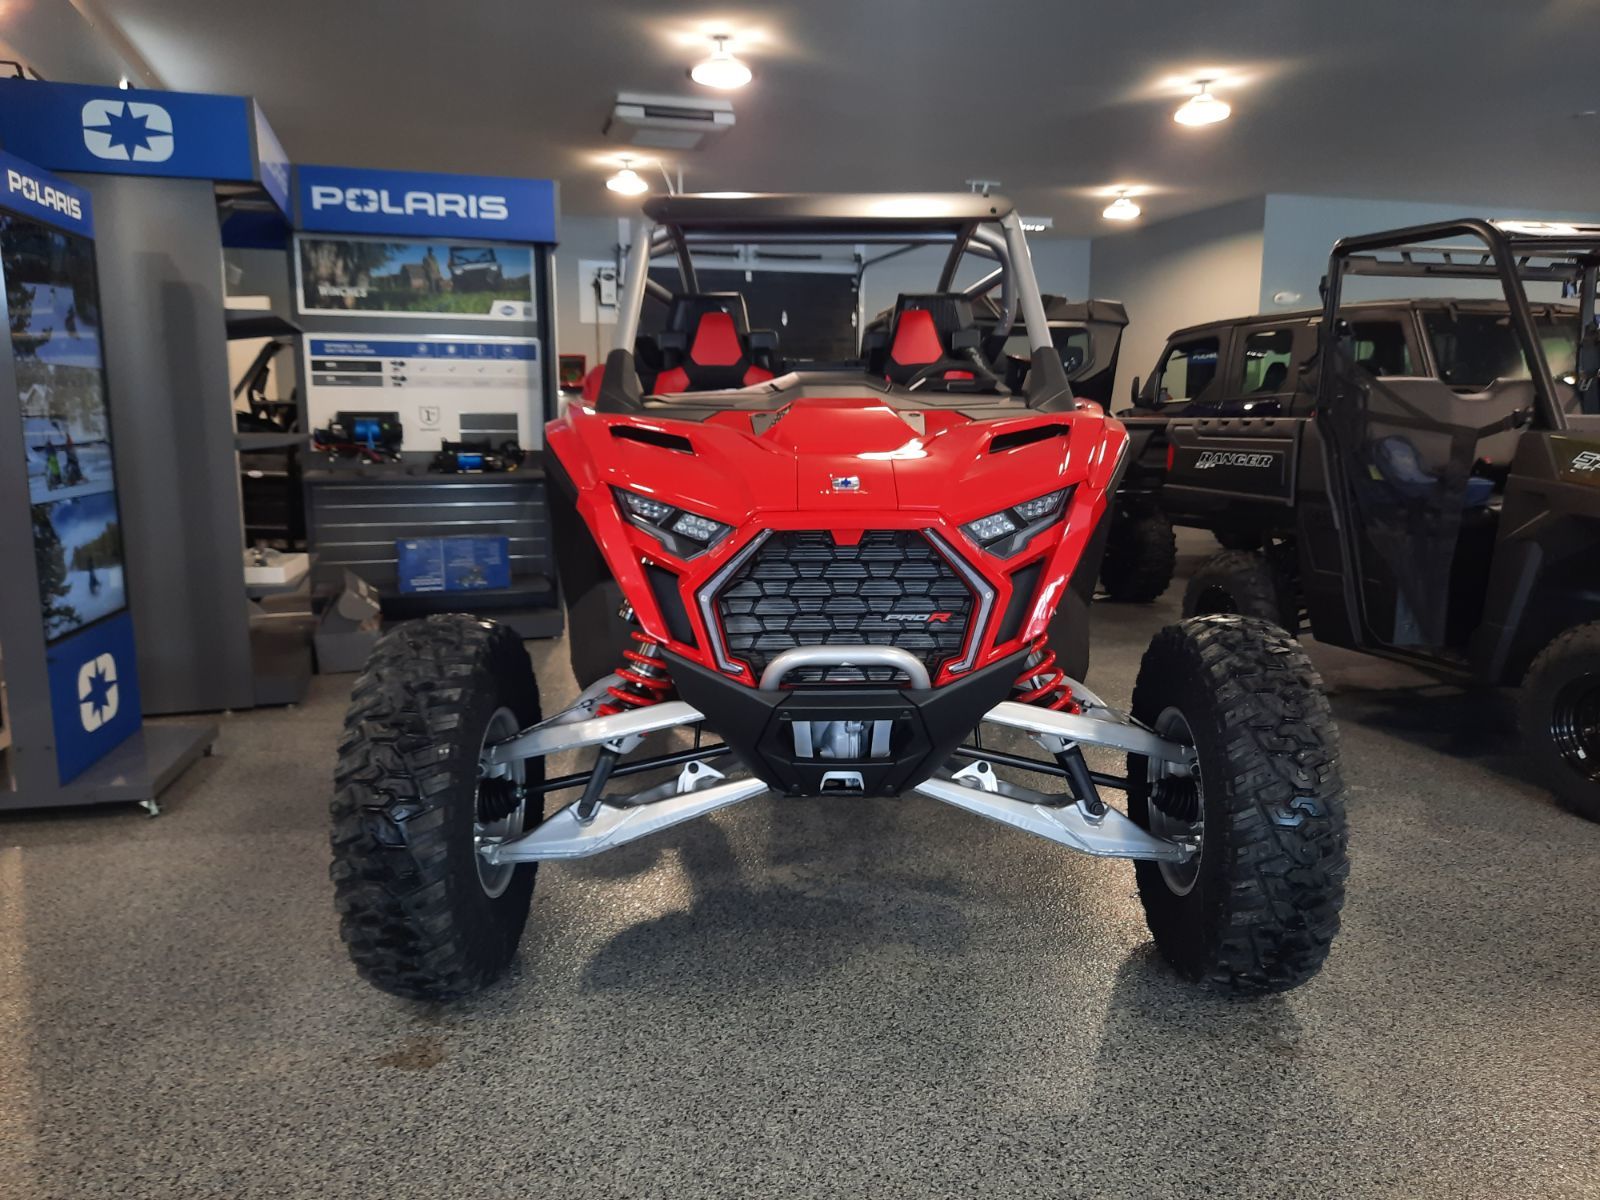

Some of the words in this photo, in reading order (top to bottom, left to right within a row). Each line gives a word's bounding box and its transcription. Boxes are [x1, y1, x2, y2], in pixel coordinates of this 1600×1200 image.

[7, 168, 82, 221] POLARIS
[311, 185, 508, 221] POLARIS
[1198, 451, 1274, 468] RANGER
